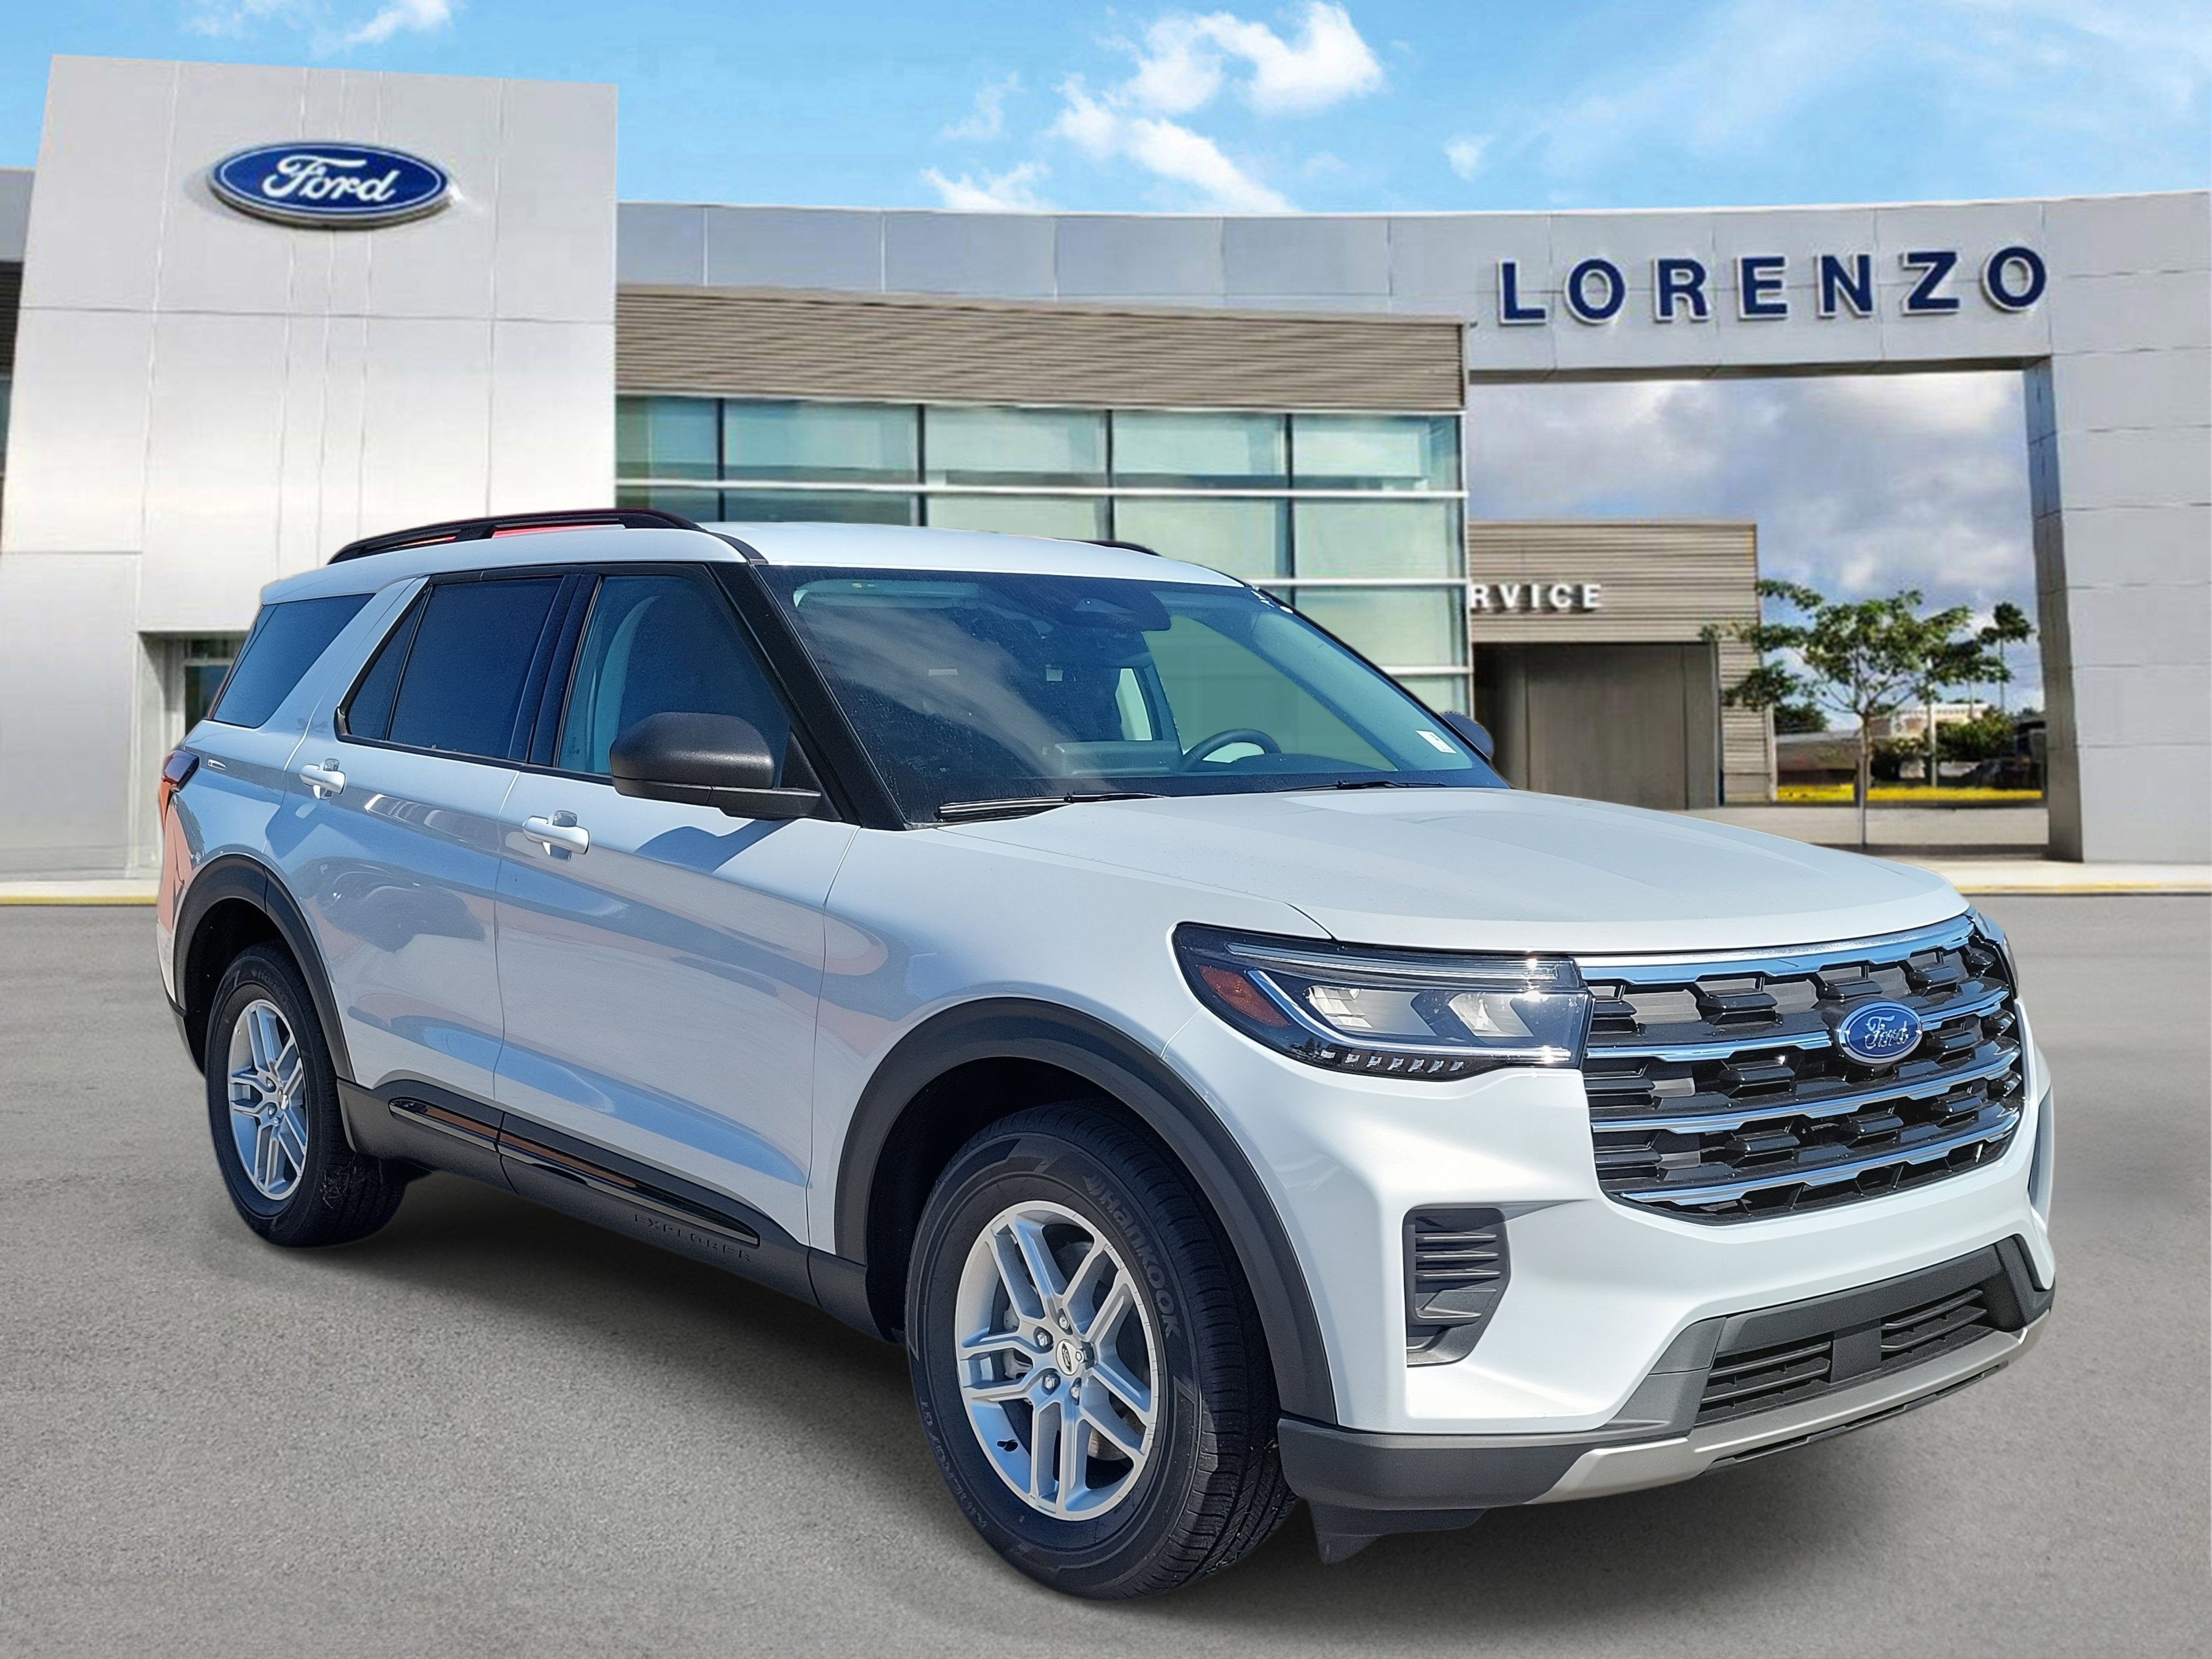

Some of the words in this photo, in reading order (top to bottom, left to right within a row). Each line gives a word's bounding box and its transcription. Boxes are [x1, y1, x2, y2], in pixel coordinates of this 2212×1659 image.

[263, 155, 401, 201] Ford
[1498, 246, 2047, 325] LORENZO
[1865, 1015, 1909, 1049] Ford
[634, 1213, 751, 1261] EXPLORER
